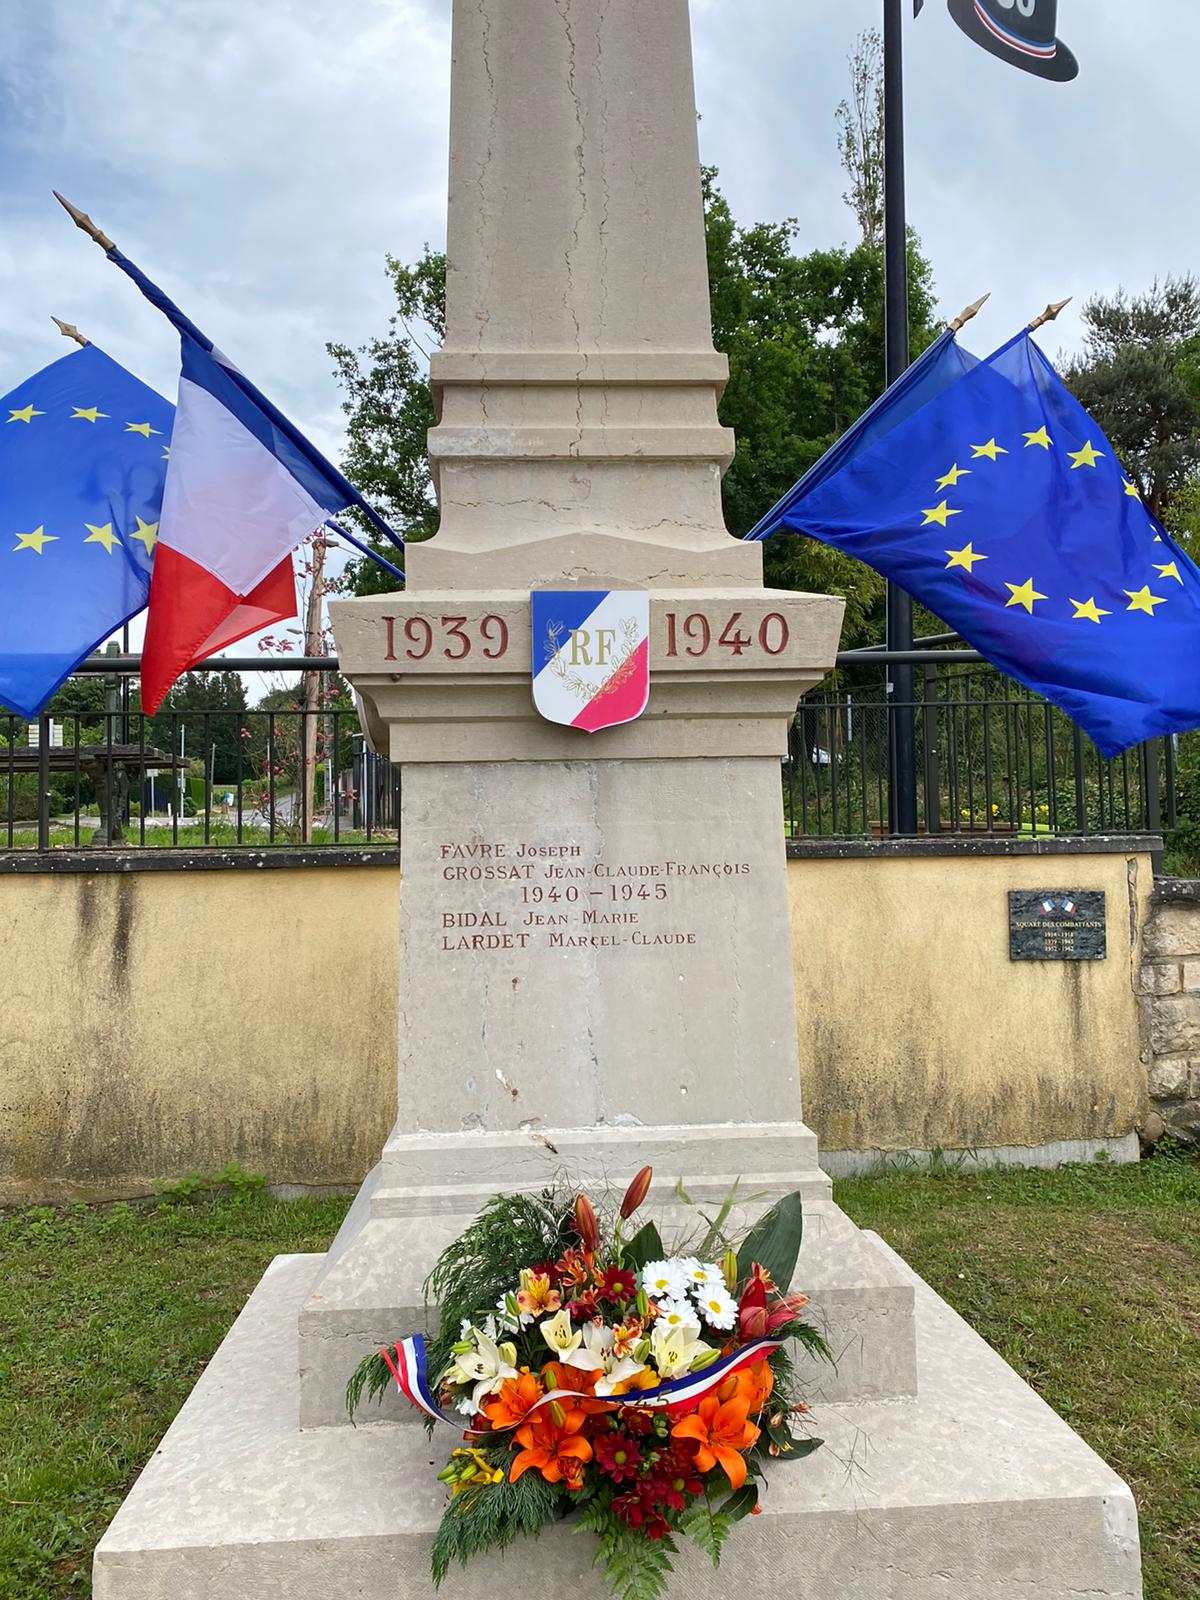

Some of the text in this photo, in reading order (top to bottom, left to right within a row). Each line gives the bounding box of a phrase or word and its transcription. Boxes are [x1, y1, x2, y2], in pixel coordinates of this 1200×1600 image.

[382, 614, 509, 662] 1939
[665, 612, 790, 657] 1940
[568, 629, 616, 666] RF
[440, 843, 506, 859] FAVRE
[443, 865, 535, 881] GROSSAT
[520, 886, 579, 904] 1940
[609, 883, 668, 902] 1945
[442, 911, 507, 929] BIDAL
[1015, 921, 1041, 929] SQUARE
[442, 933, 530, 951] LARDET
